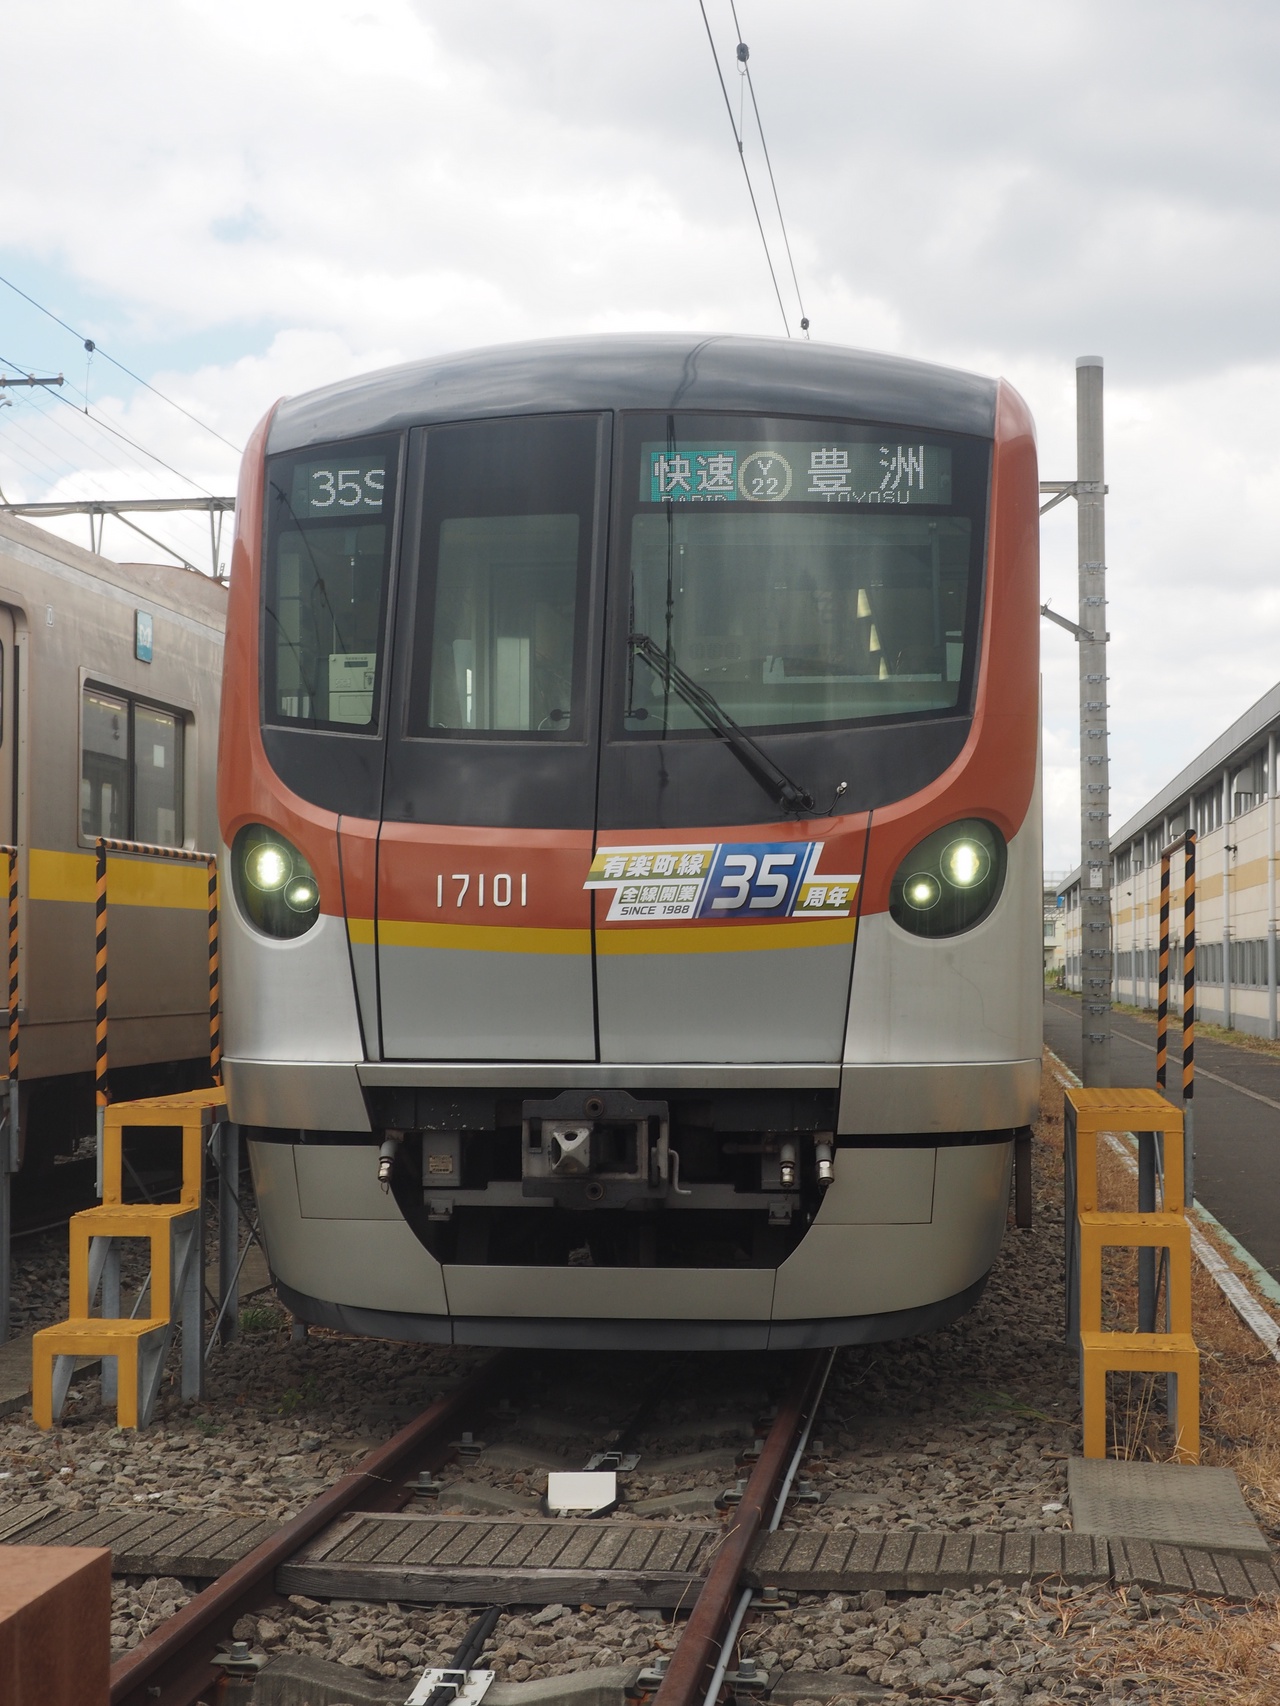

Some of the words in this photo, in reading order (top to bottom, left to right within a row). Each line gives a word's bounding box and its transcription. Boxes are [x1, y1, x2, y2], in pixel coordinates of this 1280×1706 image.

[654, 454, 734, 492] 快速
[757, 460, 773, 475] Y
[807, 445, 924, 492] 豊洲
[311, 469, 386, 507] 35S
[752, 477, 779, 495] 22
[603, 853, 705, 879] 有楽町線
[437, 873, 527, 907] 17101
[620, 885, 697, 903] 全線開業
[710, 853, 797, 910] 35
[803, 886, 850, 907] 周年
[620, 905, 657, 916] SINCE
[662, 905, 690, 915] 1988
